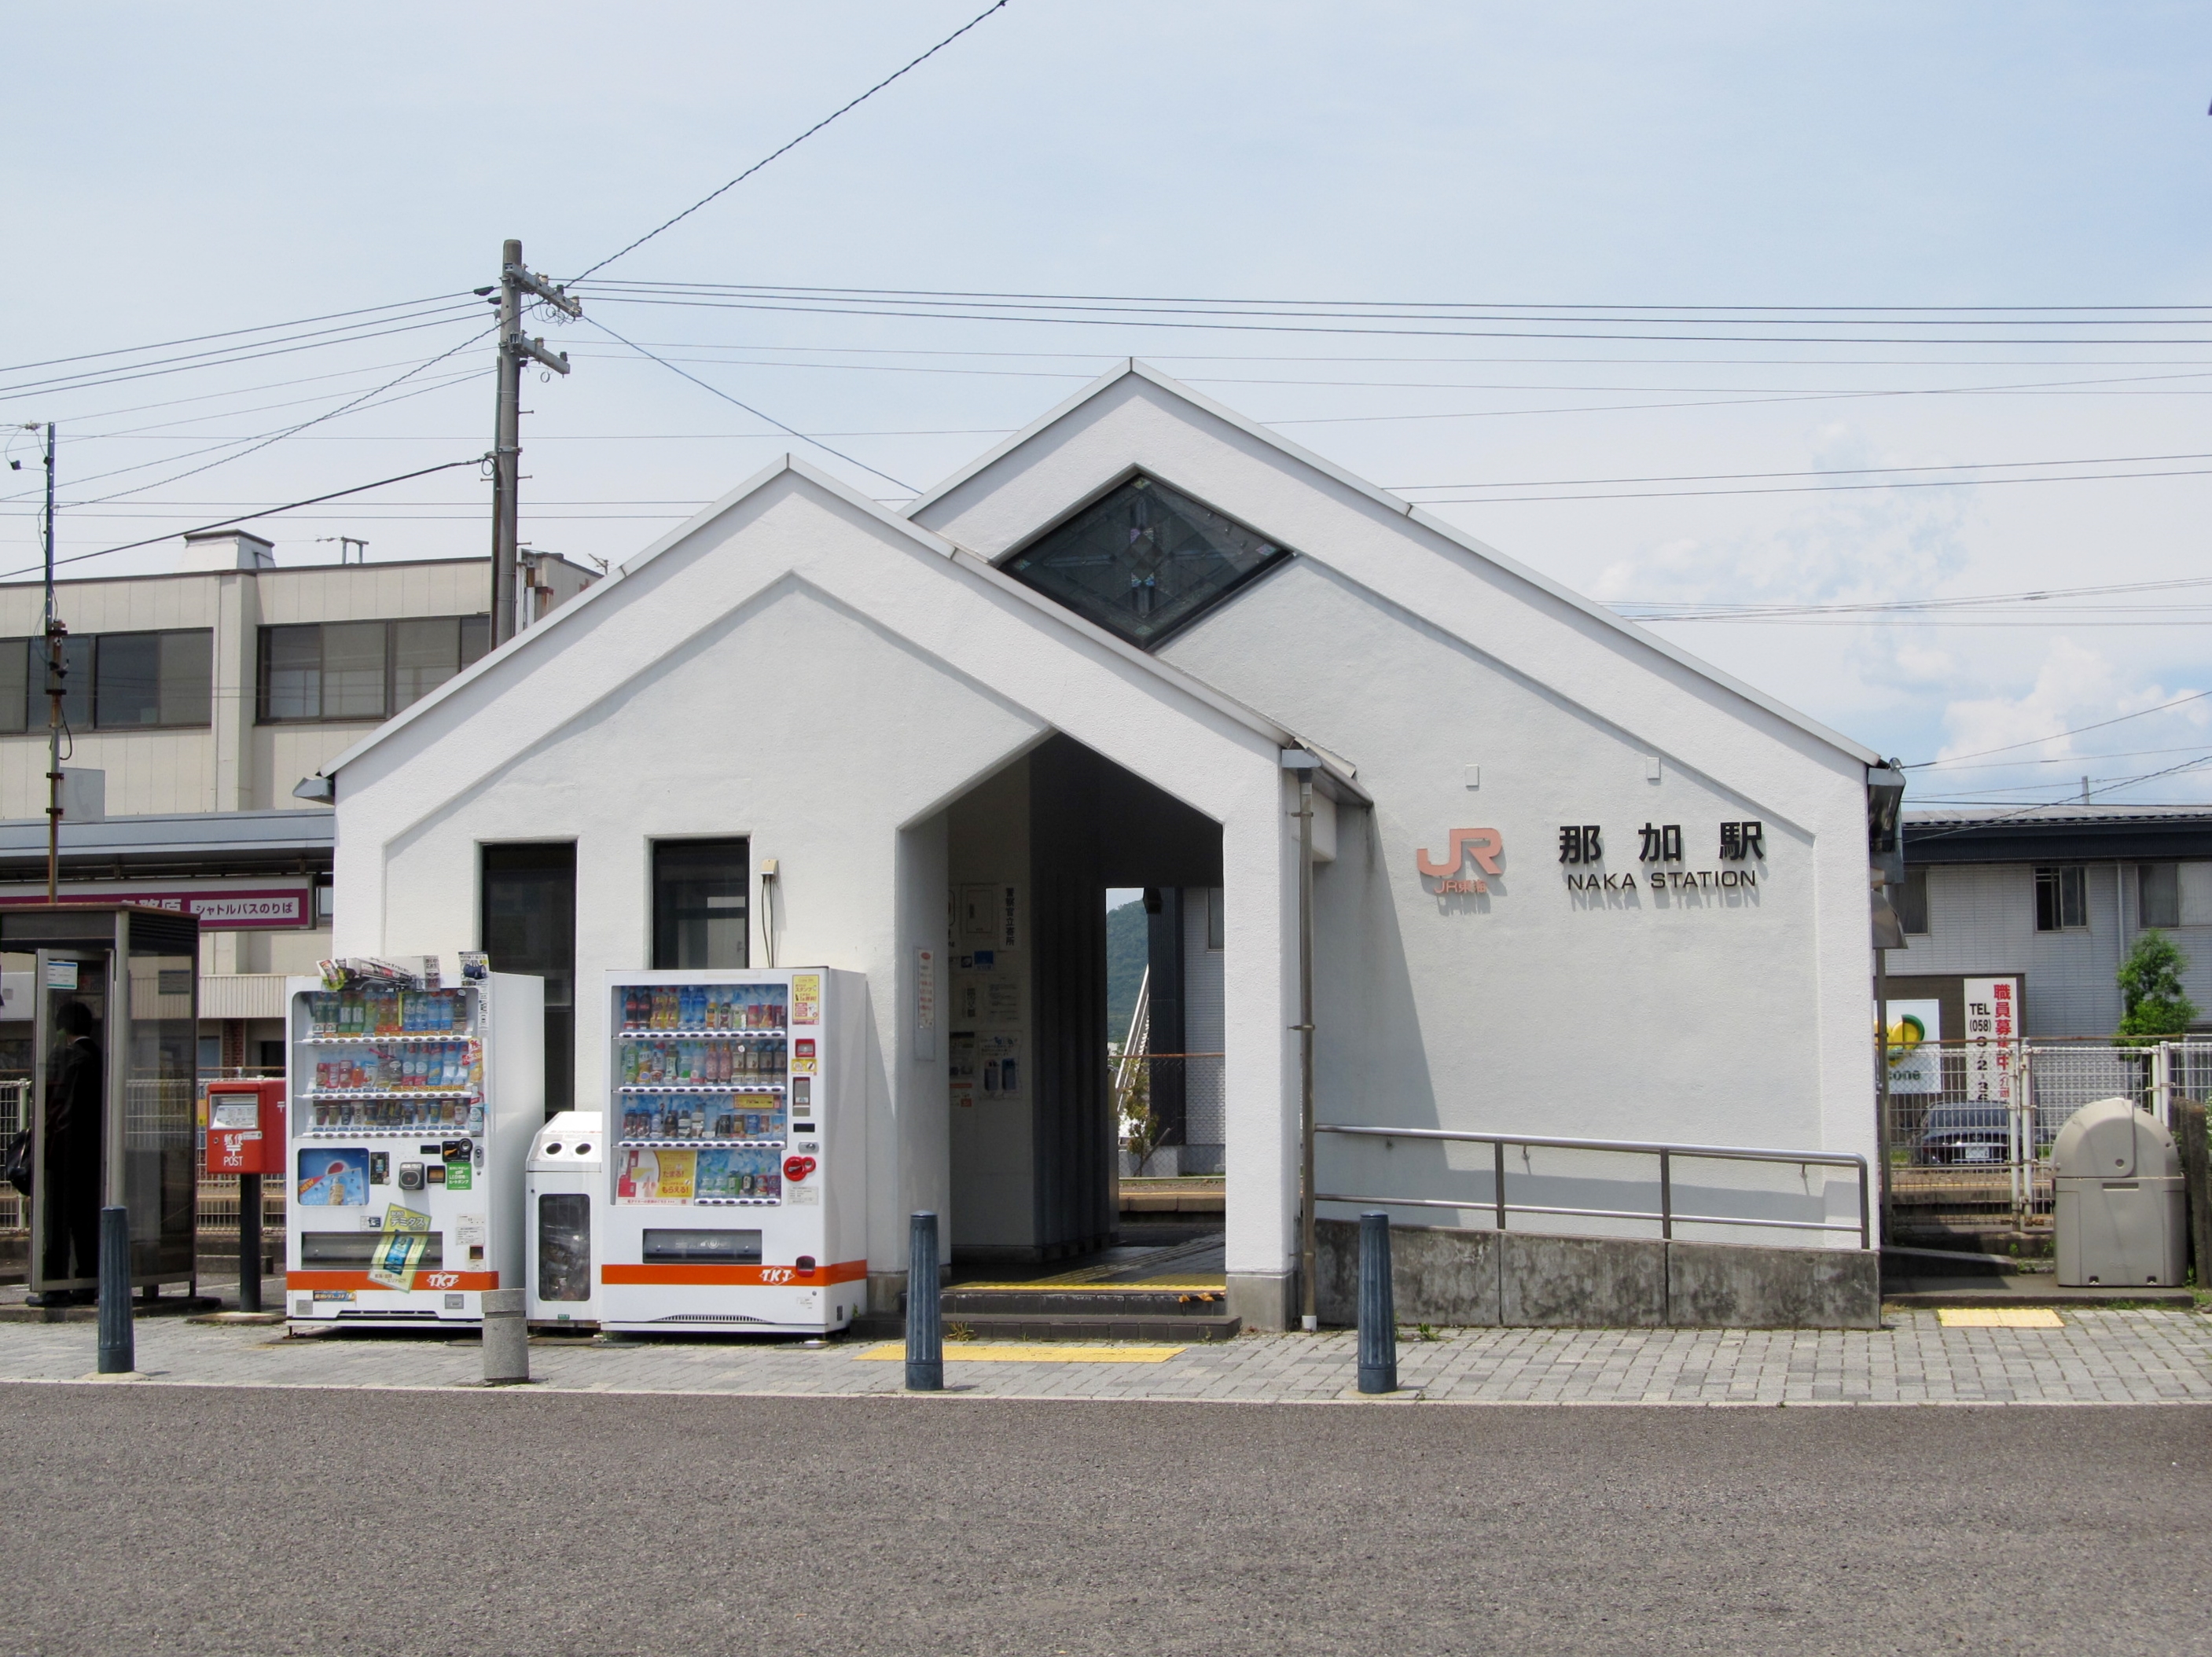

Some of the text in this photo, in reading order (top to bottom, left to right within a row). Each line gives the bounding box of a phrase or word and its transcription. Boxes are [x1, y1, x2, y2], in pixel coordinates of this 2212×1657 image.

[1559, 821, 1764, 864] 那加駅
[1416, 828, 1502, 876] JR
[1435, 880, 1488, 894] JR東海
[1567, 870, 1755, 890] NAKA STATION
[195, 901, 293, 915] シャトルバスのりば
[1005, 887, 1015, 946] 警察官立寄所
[1969, 1003, 1990, 1015] TEL
[1969, 1019, 1991, 1032] (058)
[1888, 1071, 1921, 1082] one
[224, 1133, 244, 1145] 郵便
[223, 1155, 244, 1167] POST
[299, 1178, 314, 1192] NEW
[391, 1217, 426, 1227] デミタス
